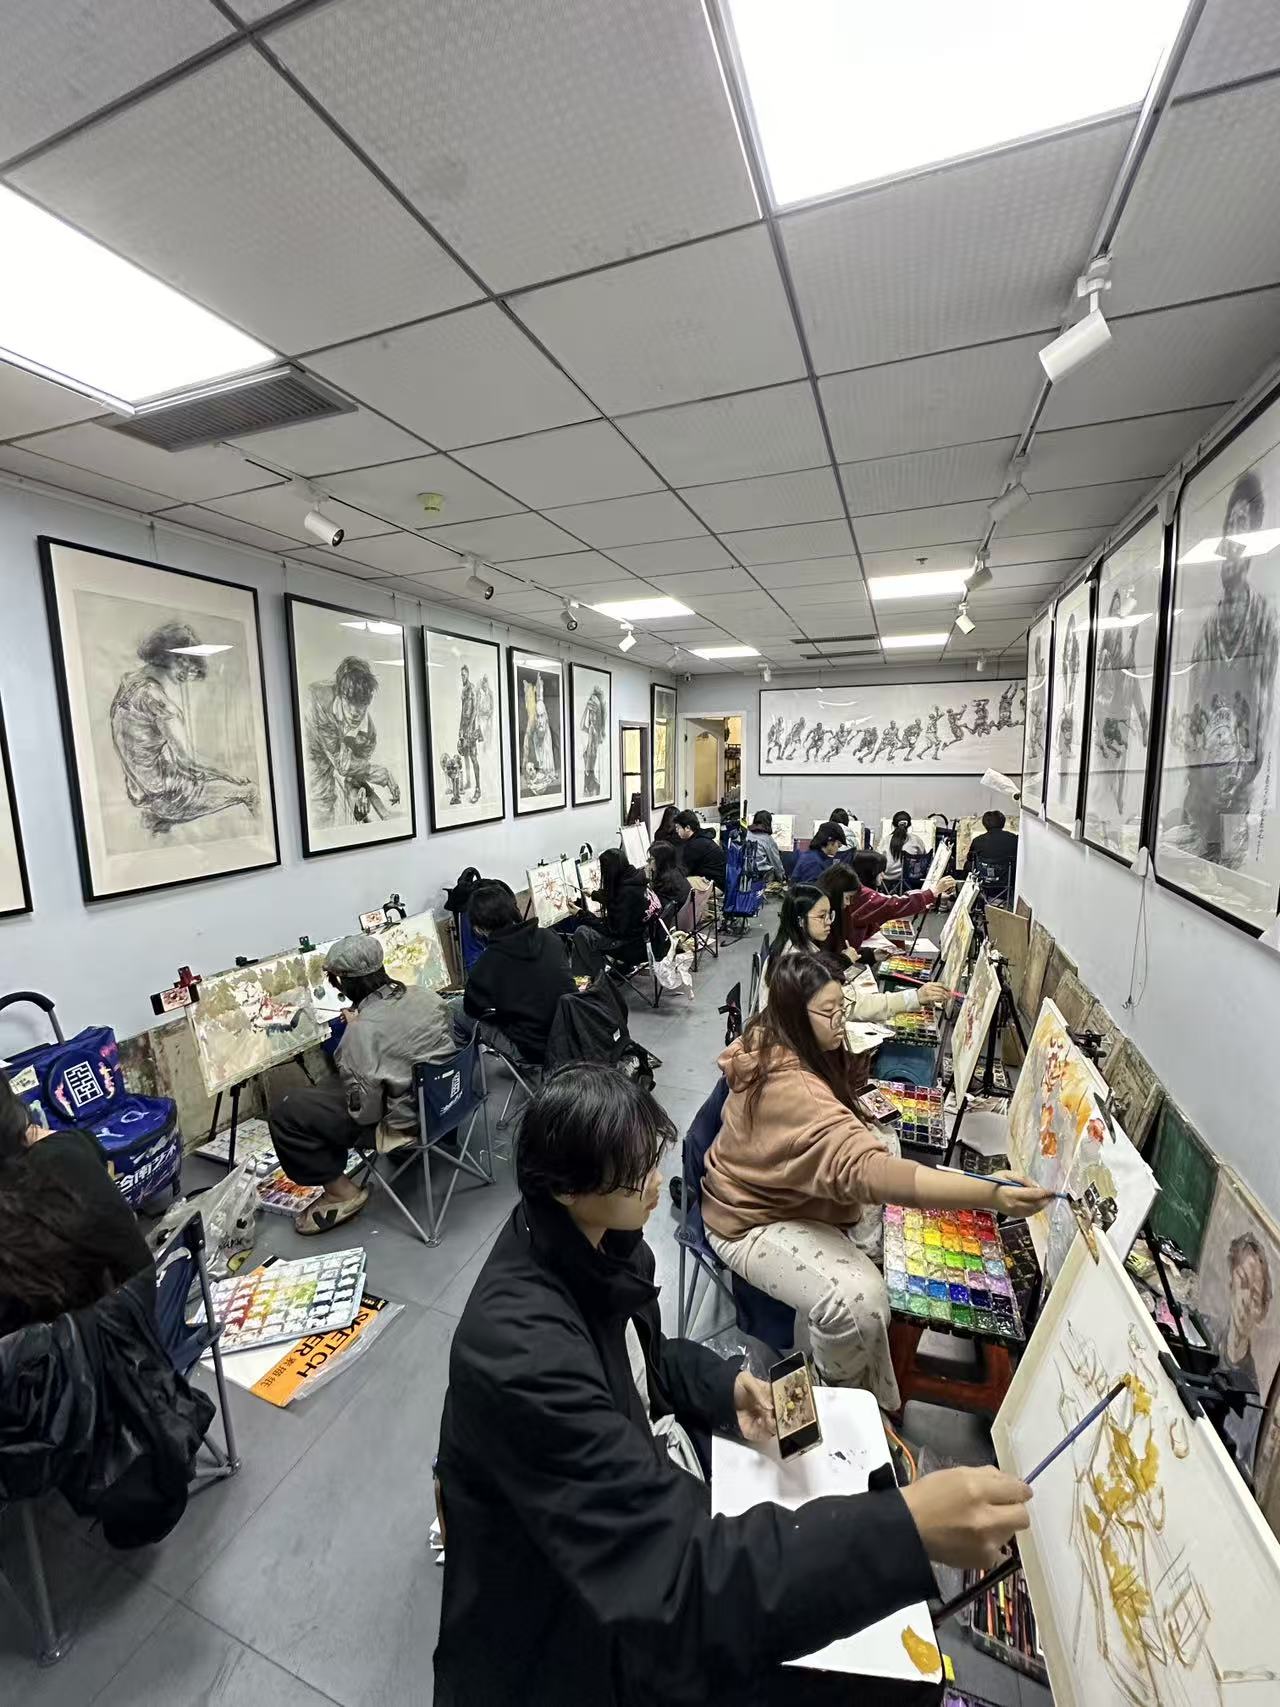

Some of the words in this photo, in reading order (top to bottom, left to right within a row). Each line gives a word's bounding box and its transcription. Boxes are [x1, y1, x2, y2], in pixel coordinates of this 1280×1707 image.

[296, 1310, 370, 1378] SKETCH
[260, 1356, 297, 1388] 素描纸
